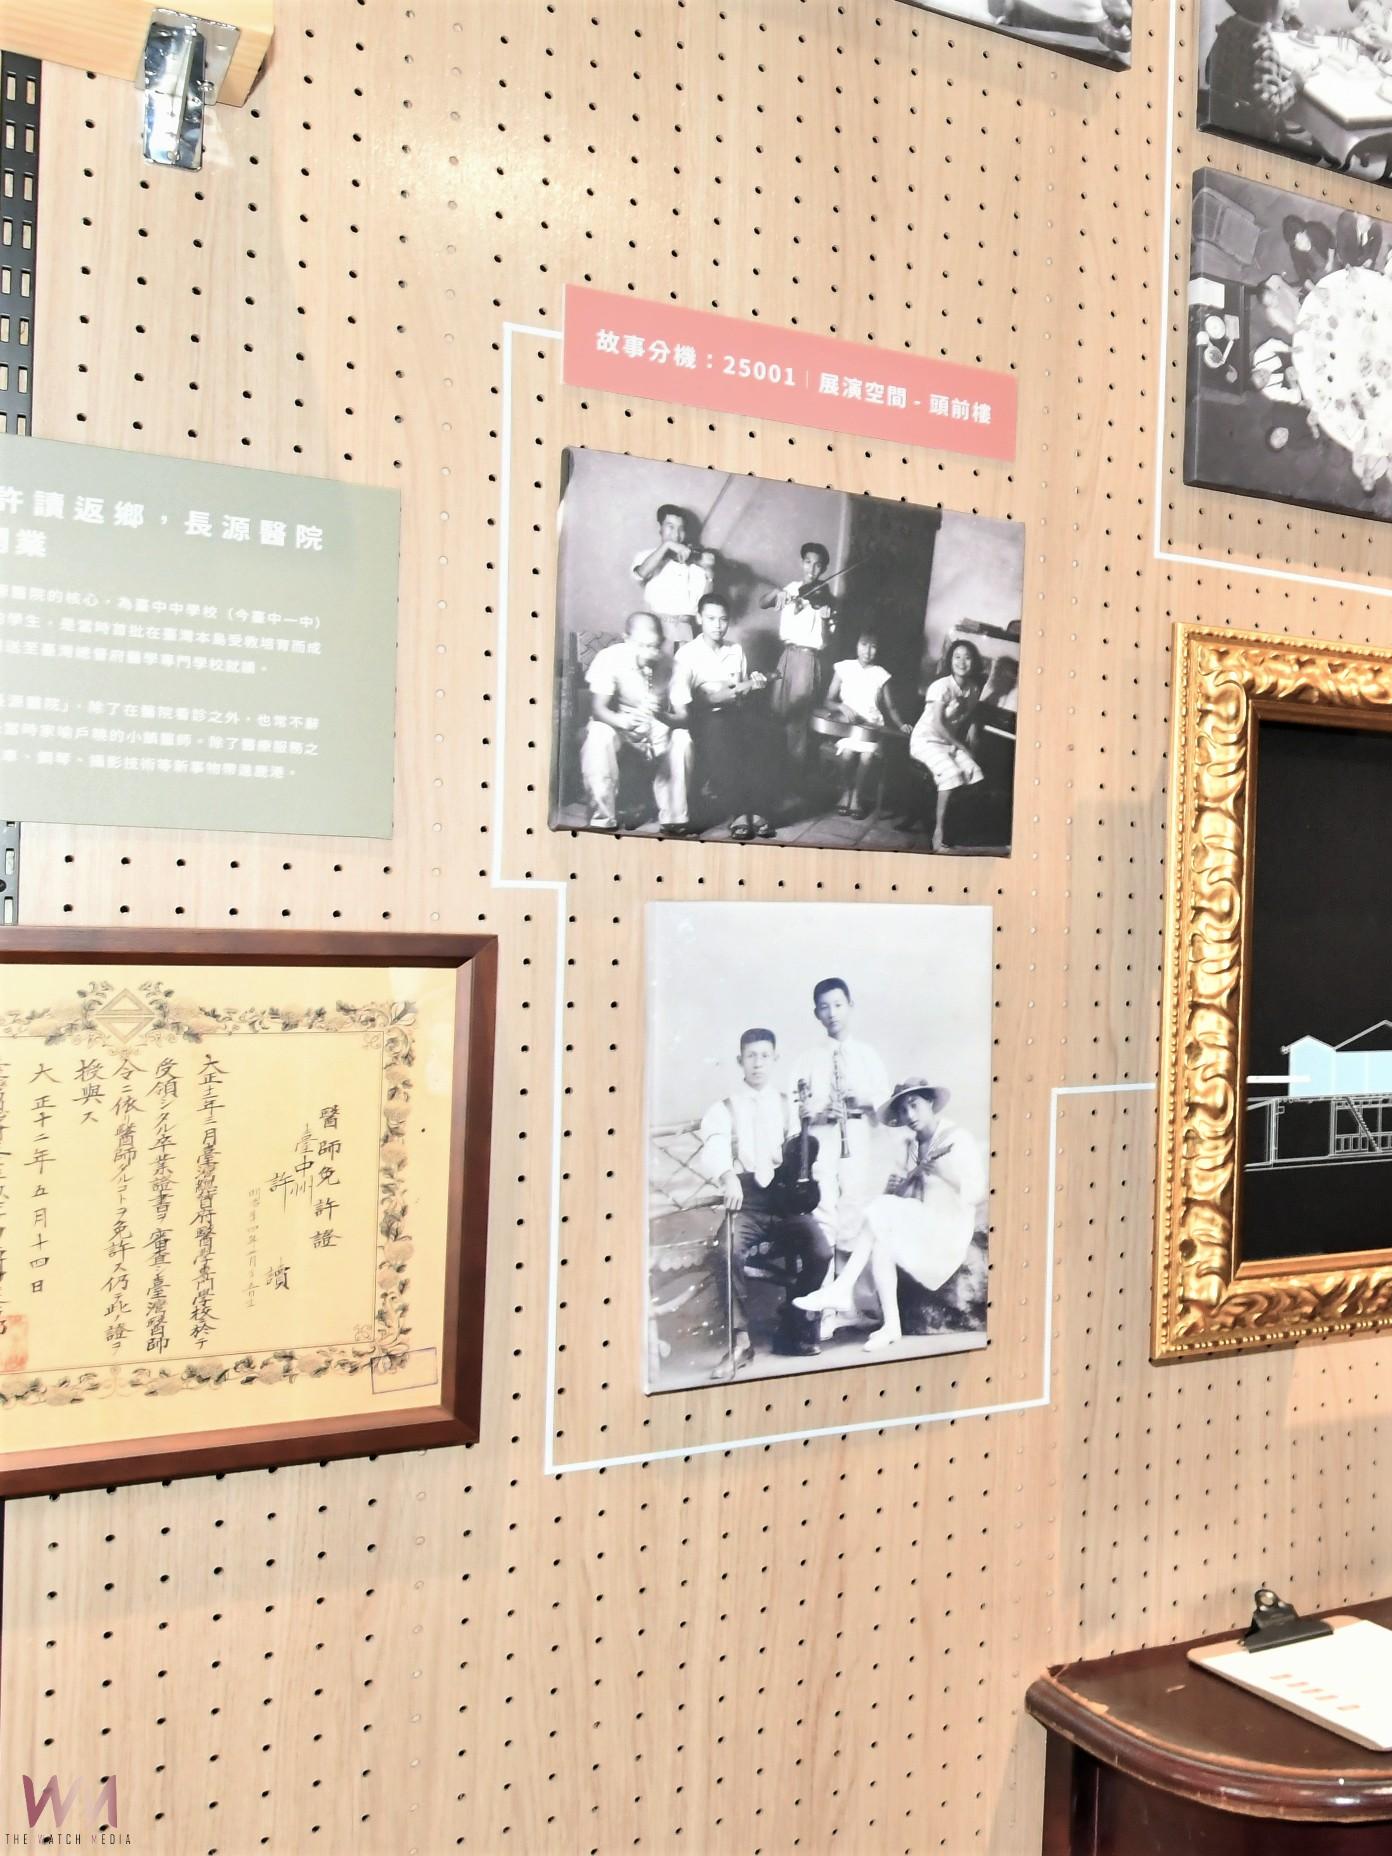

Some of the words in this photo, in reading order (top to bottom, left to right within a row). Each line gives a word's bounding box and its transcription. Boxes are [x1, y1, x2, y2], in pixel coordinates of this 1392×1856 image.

[595, 328, 797, 388] 故事分機：25001
[818, 372, 907, 409] 展演空間
[928, 393, 992, 424] 頭前樓
